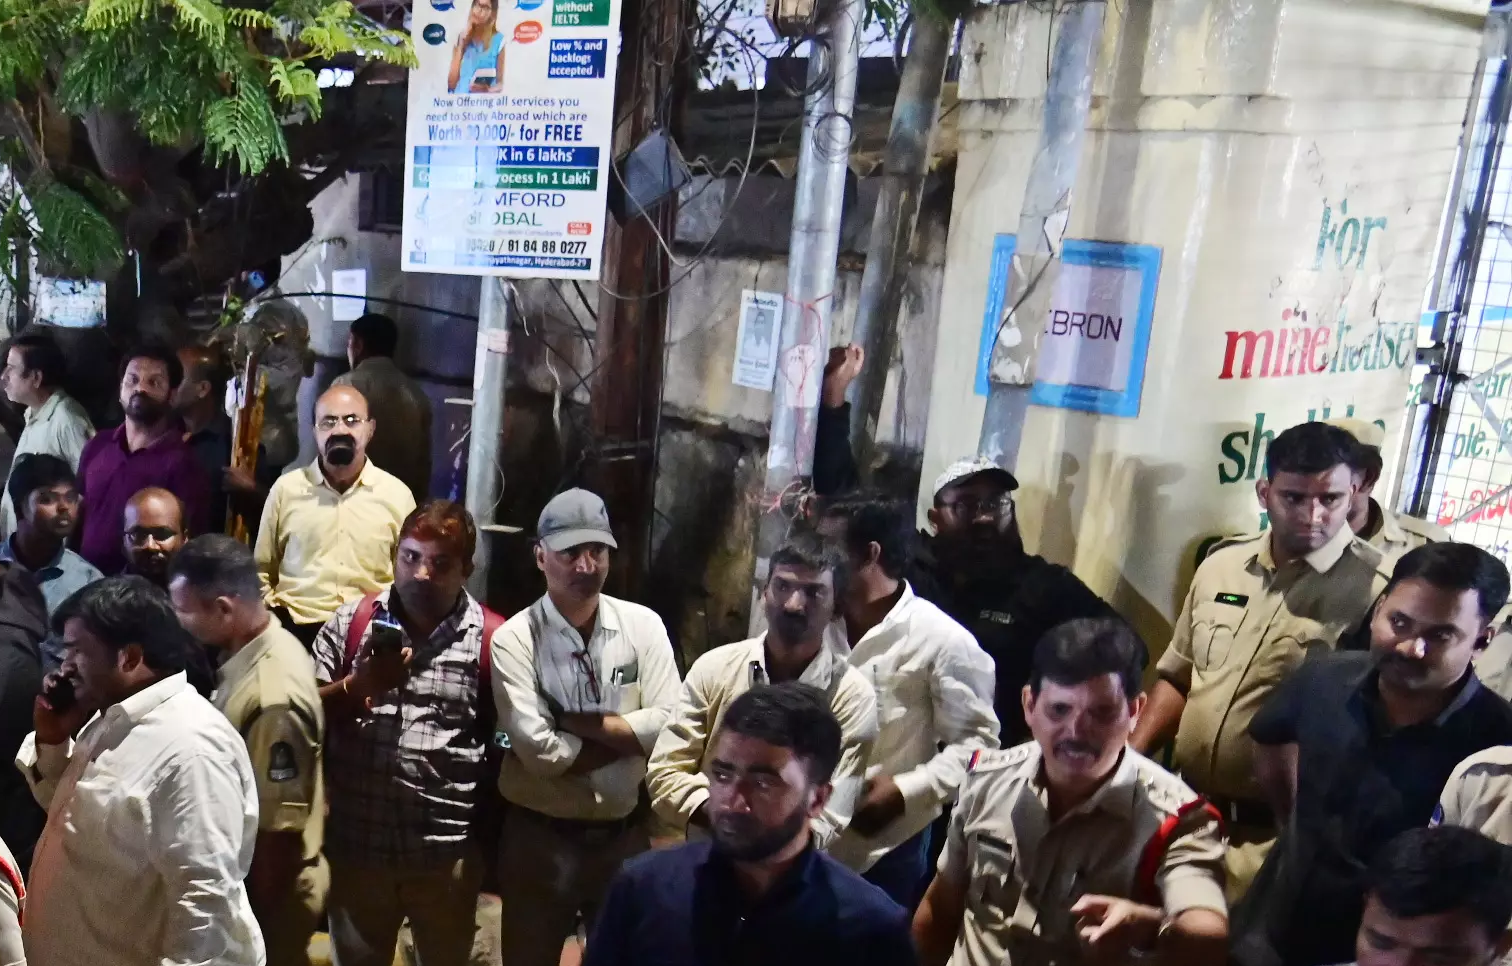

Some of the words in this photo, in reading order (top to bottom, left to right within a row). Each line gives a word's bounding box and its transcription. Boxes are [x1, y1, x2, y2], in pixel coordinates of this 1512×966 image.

[555, 1, 594, 12] without
[554, 13, 580, 24] IELTS
[551, 40, 571, 51] Low
[574, 40, 582, 51] %
[584, 40, 603, 51] and
[550, 52, 592, 65] backlogs
[549, 65, 593, 78] accepted
[433, 97, 454, 107] Now
[456, 96, 494, 109] Offering
[496, 96, 508, 107] all
[512, 96, 555, 107] services
[559, 98, 580, 109] you
[425, 111, 448, 121] need
[450, 112, 460, 121] to
[462, 111, 489, 123] Study
[491, 110, 529, 121] Abroad
[532, 110, 566, 121] which
[569, 112, 588, 122] are
[428, 123, 462, 141] Worth
[520, 124, 540, 141] for
[544, 124, 583, 141] FREE
[510, 147, 524, 162] in
[526, 148, 535, 162] 6
[495, 172, 533, 184] rocess
[551, 171, 559, 184] 1
[508, 239, 519, 252] 81
[523, 240, 537, 253] 84
[542, 240, 556, 253] 88
[560, 241, 587, 255] 0277
[1045, 309, 1123, 342] BRON
